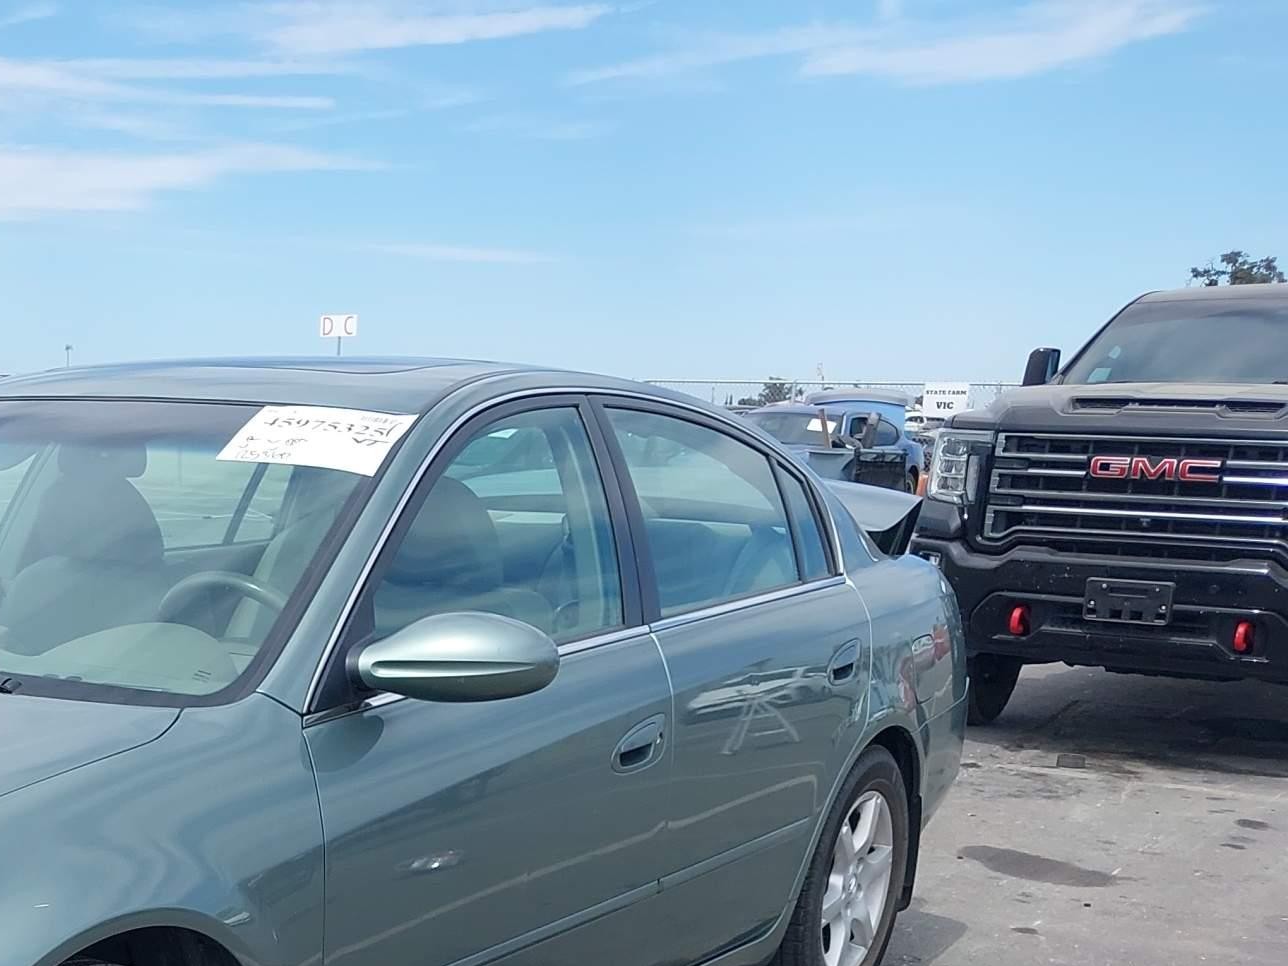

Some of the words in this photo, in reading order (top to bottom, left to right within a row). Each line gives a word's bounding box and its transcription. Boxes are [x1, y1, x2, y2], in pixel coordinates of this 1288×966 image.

[322, 316, 334, 336] D
[344, 315, 354, 335] C
[936, 401, 954, 410] VIC
[263, 417, 387, 437] 45975325
[1089, 455, 1222, 483] GMC
